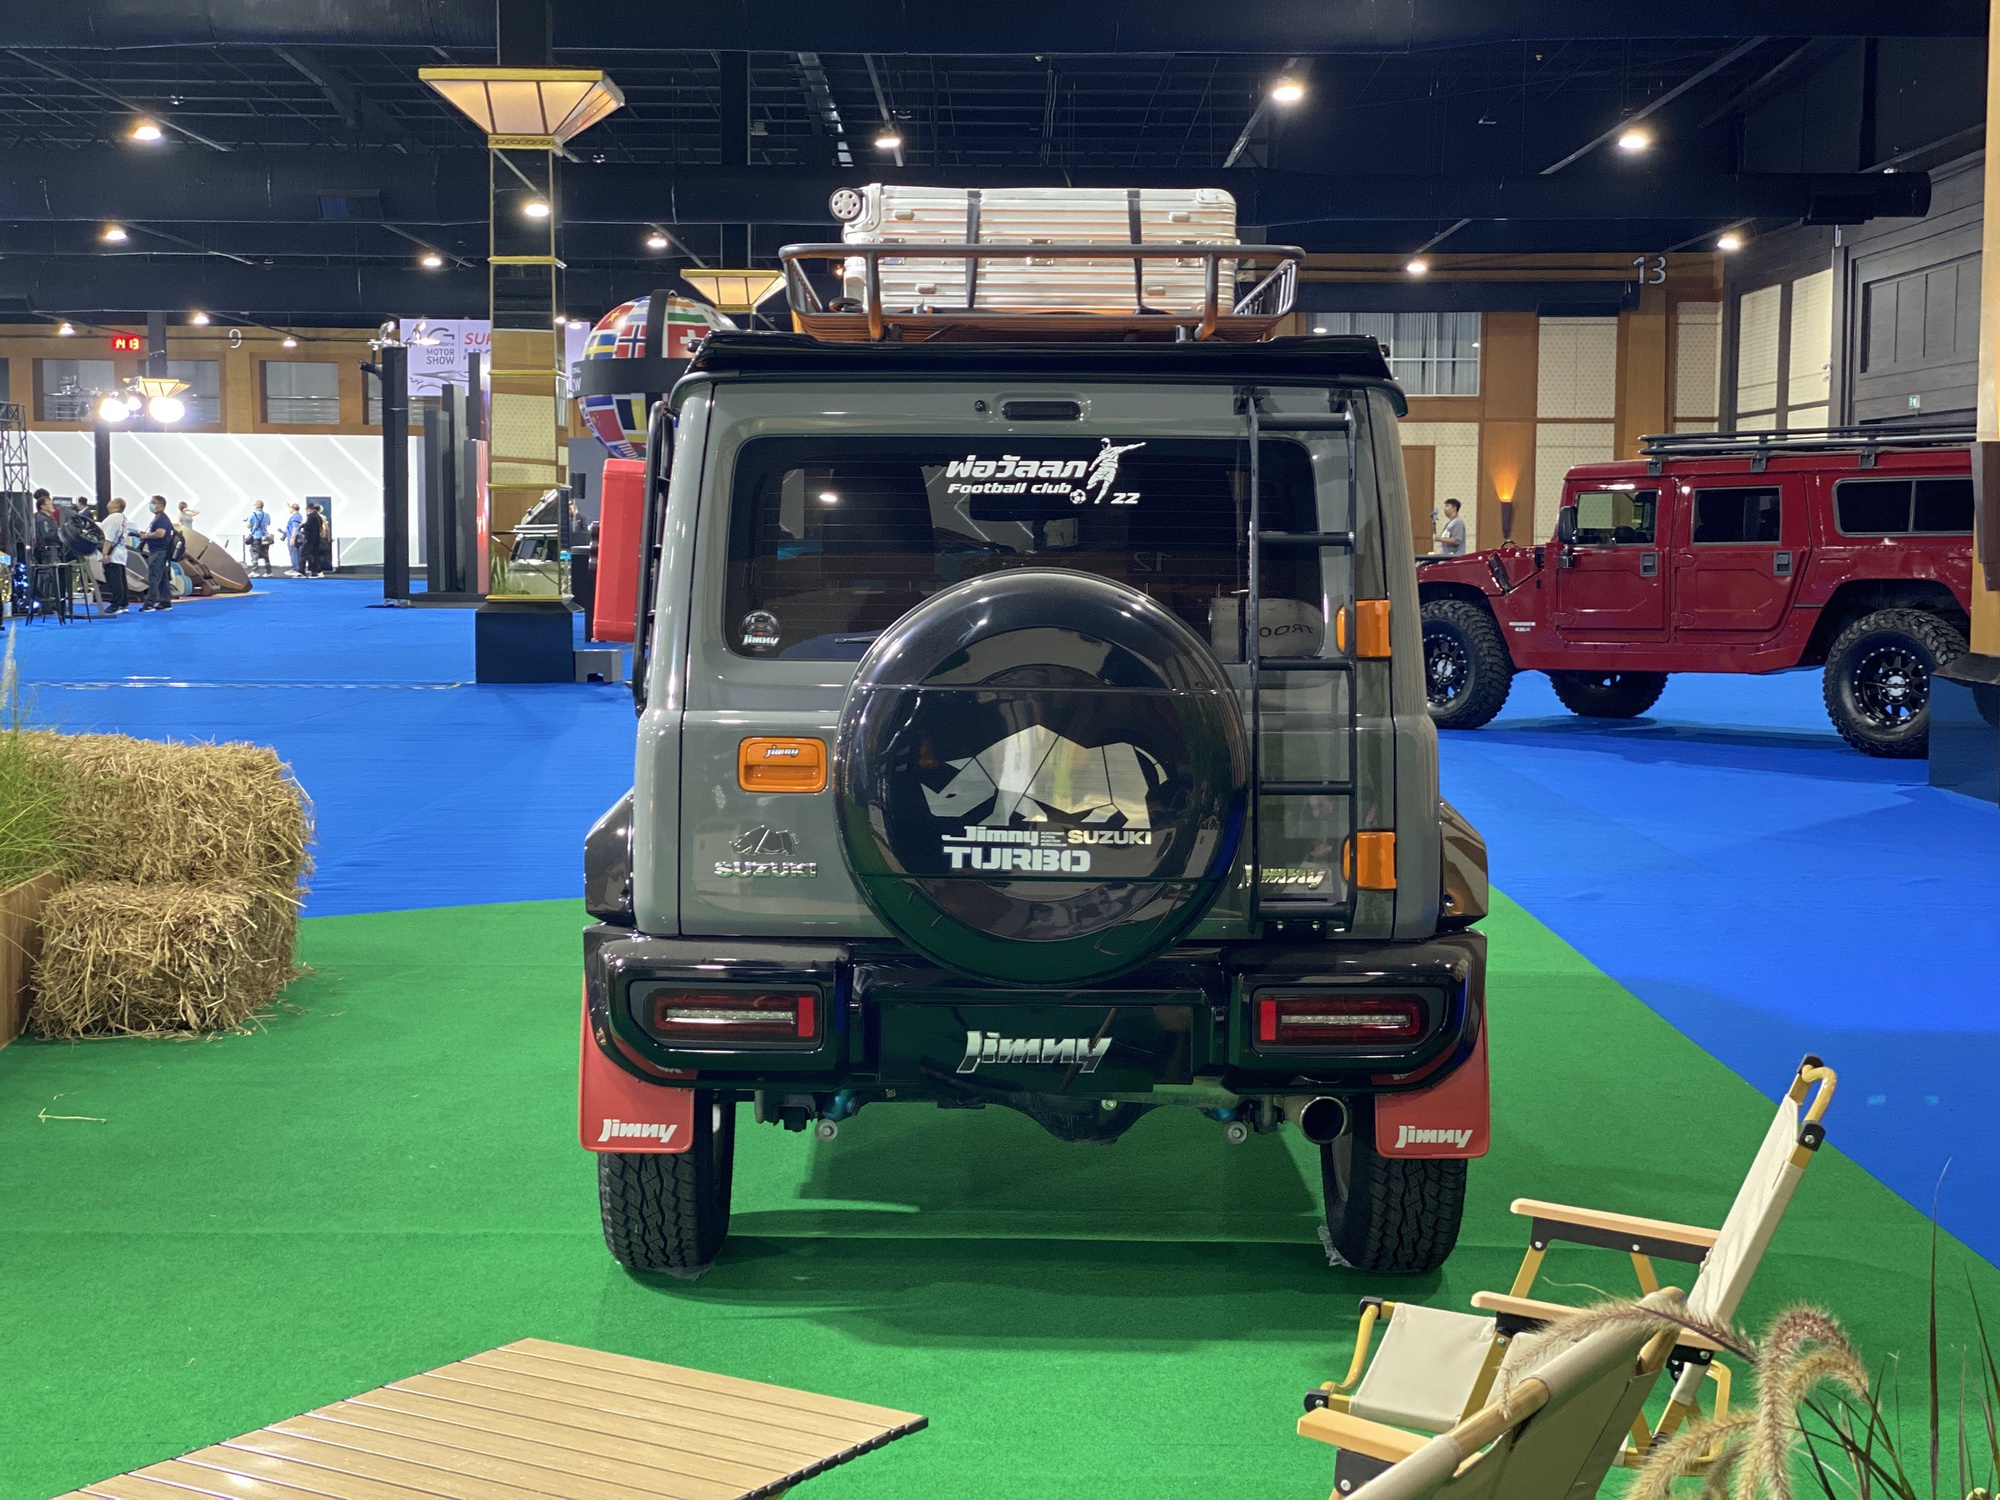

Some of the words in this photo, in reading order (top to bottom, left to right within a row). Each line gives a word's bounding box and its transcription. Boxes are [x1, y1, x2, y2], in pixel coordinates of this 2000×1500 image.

[1633, 256, 1667, 285] 13
[228, 328, 242, 349] 9
[426, 348, 455, 356] MOTOR
[426, 356, 455, 365] SHOW
[947, 482, 1026, 494] Football
[1030, 482, 1072, 494] club
[1110, 492, 1141, 505] 22
[941, 826, 1040, 846] Jimny
[1067, 829, 1152, 845] SUZUKI
[714, 860, 818, 879] SUZUKI
[943, 846, 1092, 872] TURBO
[1237, 864, 1327, 889] Jmny
[956, 1030, 1113, 1074] Jimny
[597, 1119, 678, 1143] Jimny
[1394, 1125, 1474, 1149] Jimny
